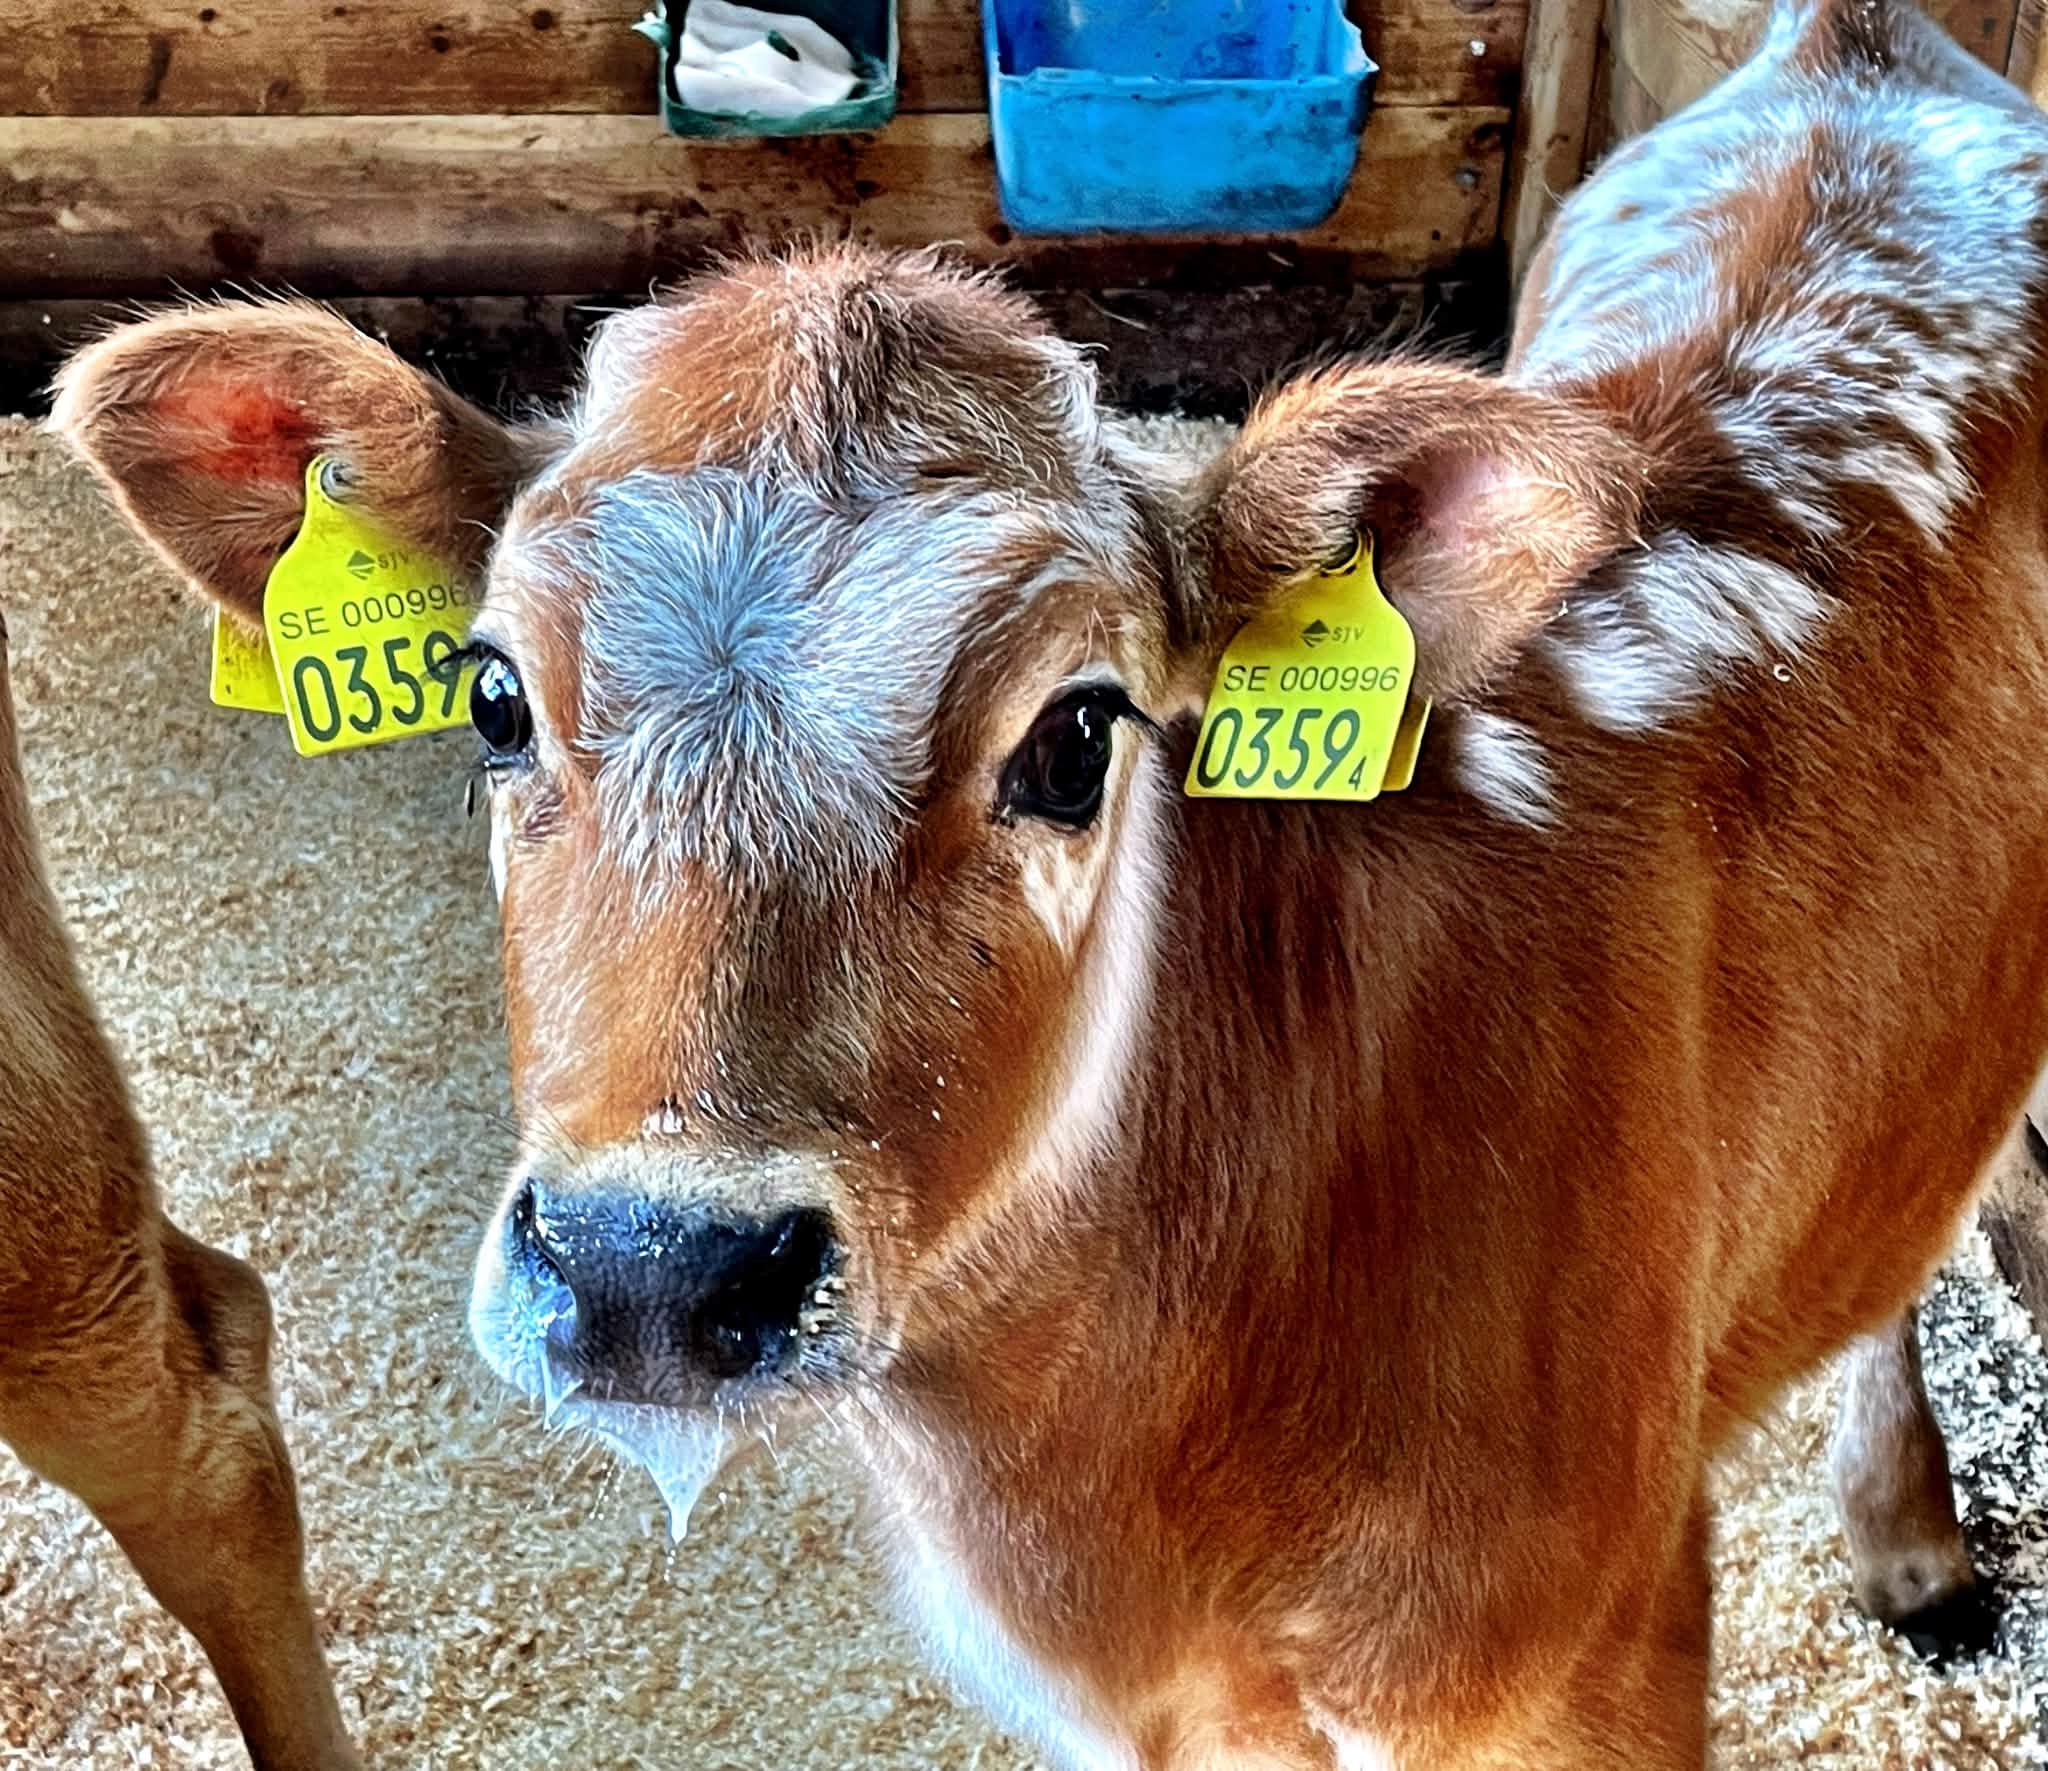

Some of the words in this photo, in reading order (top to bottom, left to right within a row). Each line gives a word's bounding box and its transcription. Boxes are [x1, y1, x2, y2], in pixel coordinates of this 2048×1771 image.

[279, 607, 330, 639] SE
[293, 631, 464, 742] 0359
[1223, 665, 1270, 691] SE
[1280, 665, 1400, 692] 000996
[1197, 707, 1360, 790] 0359
[1348, 756, 1367, 791] 4
